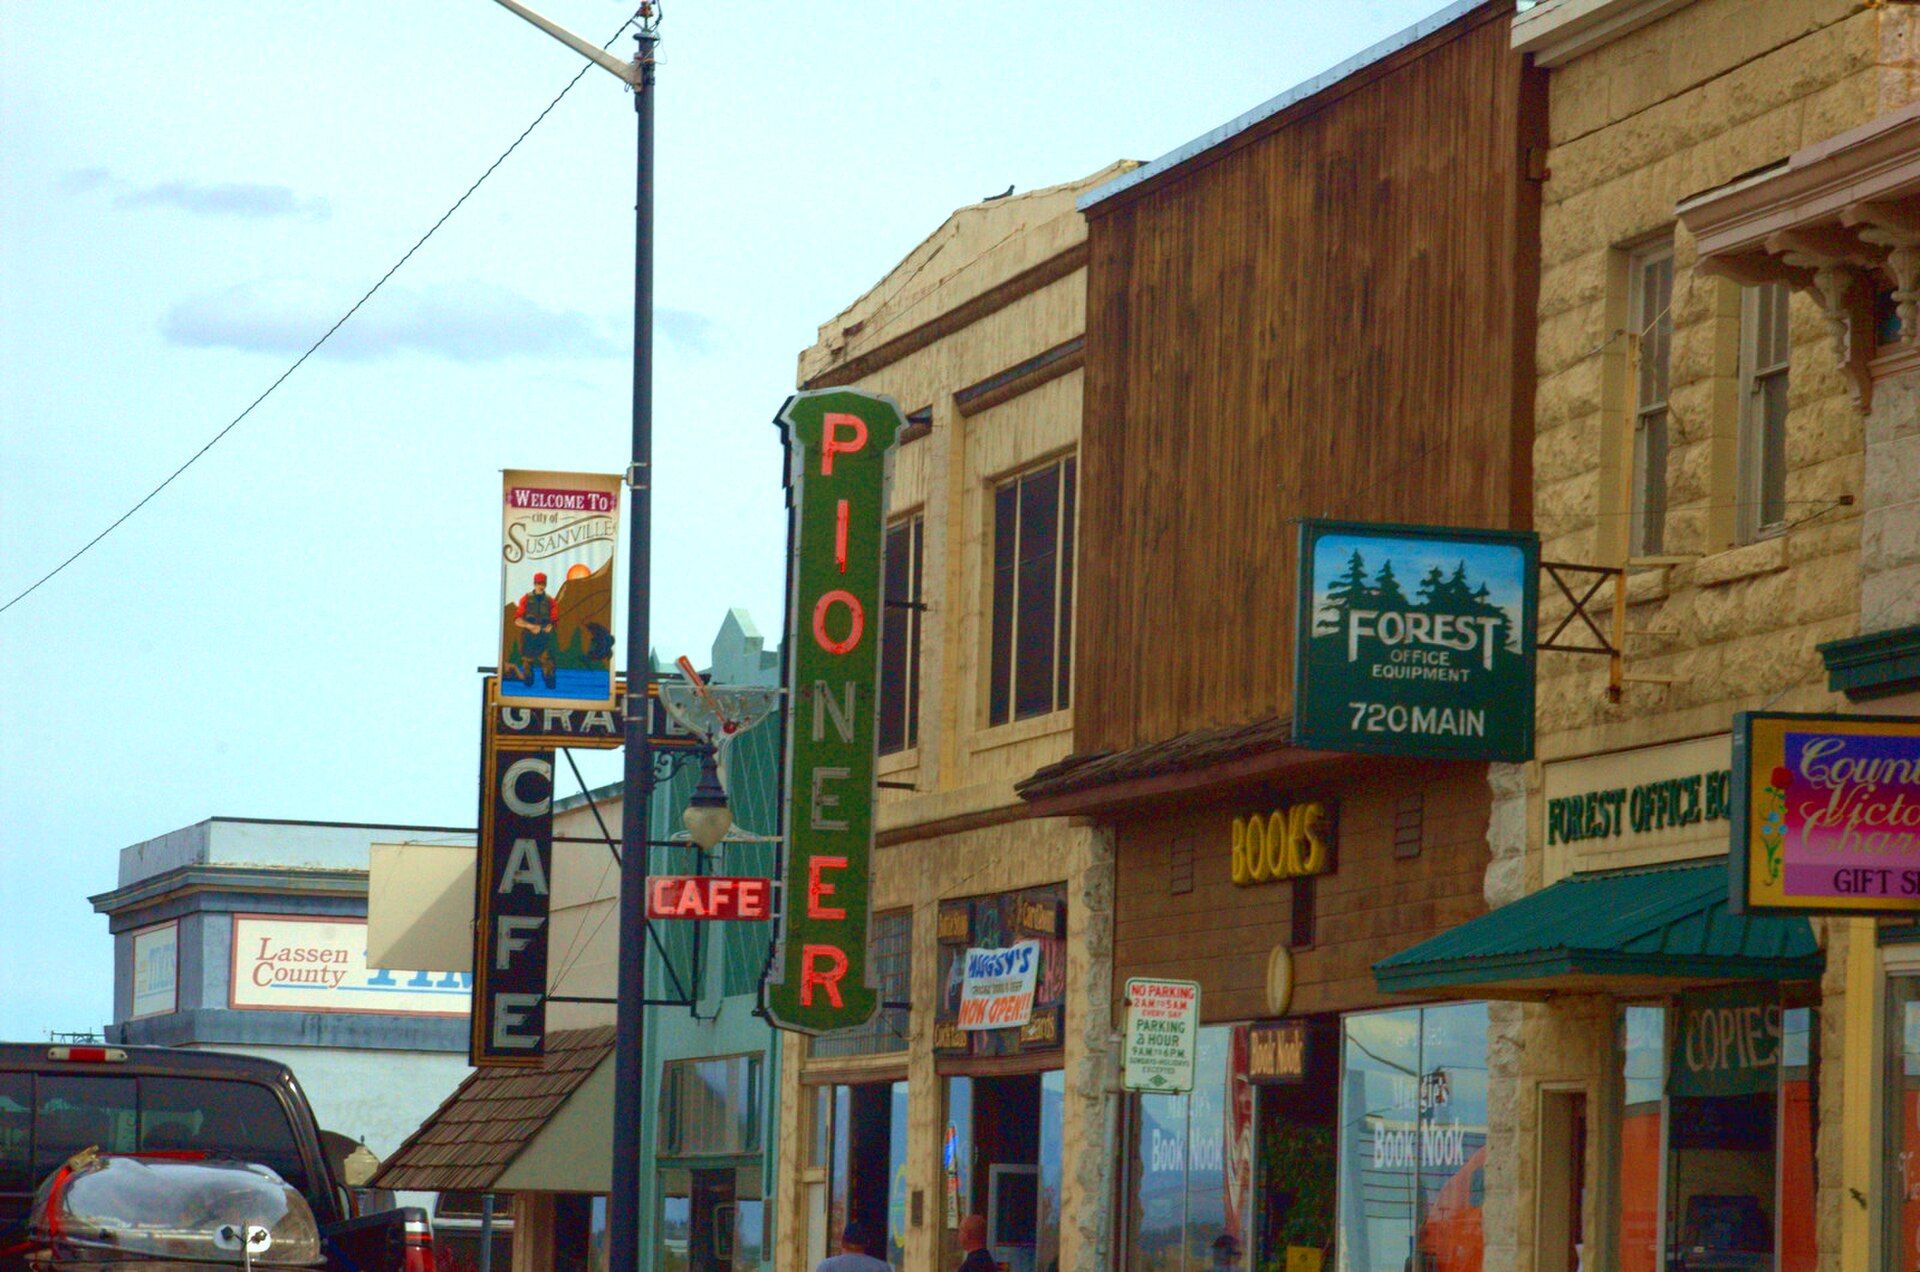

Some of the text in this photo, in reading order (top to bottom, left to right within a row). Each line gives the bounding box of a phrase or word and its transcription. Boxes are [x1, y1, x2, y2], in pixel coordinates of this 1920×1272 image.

[515, 489, 609, 511] WELCOME TO
[531, 512, 559, 524] city of
[503, 521, 614, 563] SUSANVILLE
[1348, 608, 1502, 672] FOREST
[1390, 649, 1450, 667] OFFICE
[1372, 664, 1471, 683] EQUIPMENT
[502, 699, 690, 736] GRA
[801, 412, 868, 1008] PIONEER
[1348, 702, 1486, 738] 720 MAIN
[1547, 788, 1627, 847] FOREST
[1629, 774, 1702, 834] OFFICE
[1231, 803, 1324, 884] BOOKS
[653, 878, 764, 918] CAFE
[1834, 868, 1892, 893] GIFT
[493, 758, 552, 1049] CAFE
[256, 937, 349, 964] Lassen
[252, 962, 347, 989] County
[1131, 984, 1195, 1000] NO PARKING
[1136, 1019, 1186, 1034] PARKING
[1148, 1034, 1180, 1047] HOUR
[1685, 1004, 1780, 1072] COPIES
[1151, 1128, 1185, 1172] Book
[1374, 1118, 1465, 1168] Book Nook
